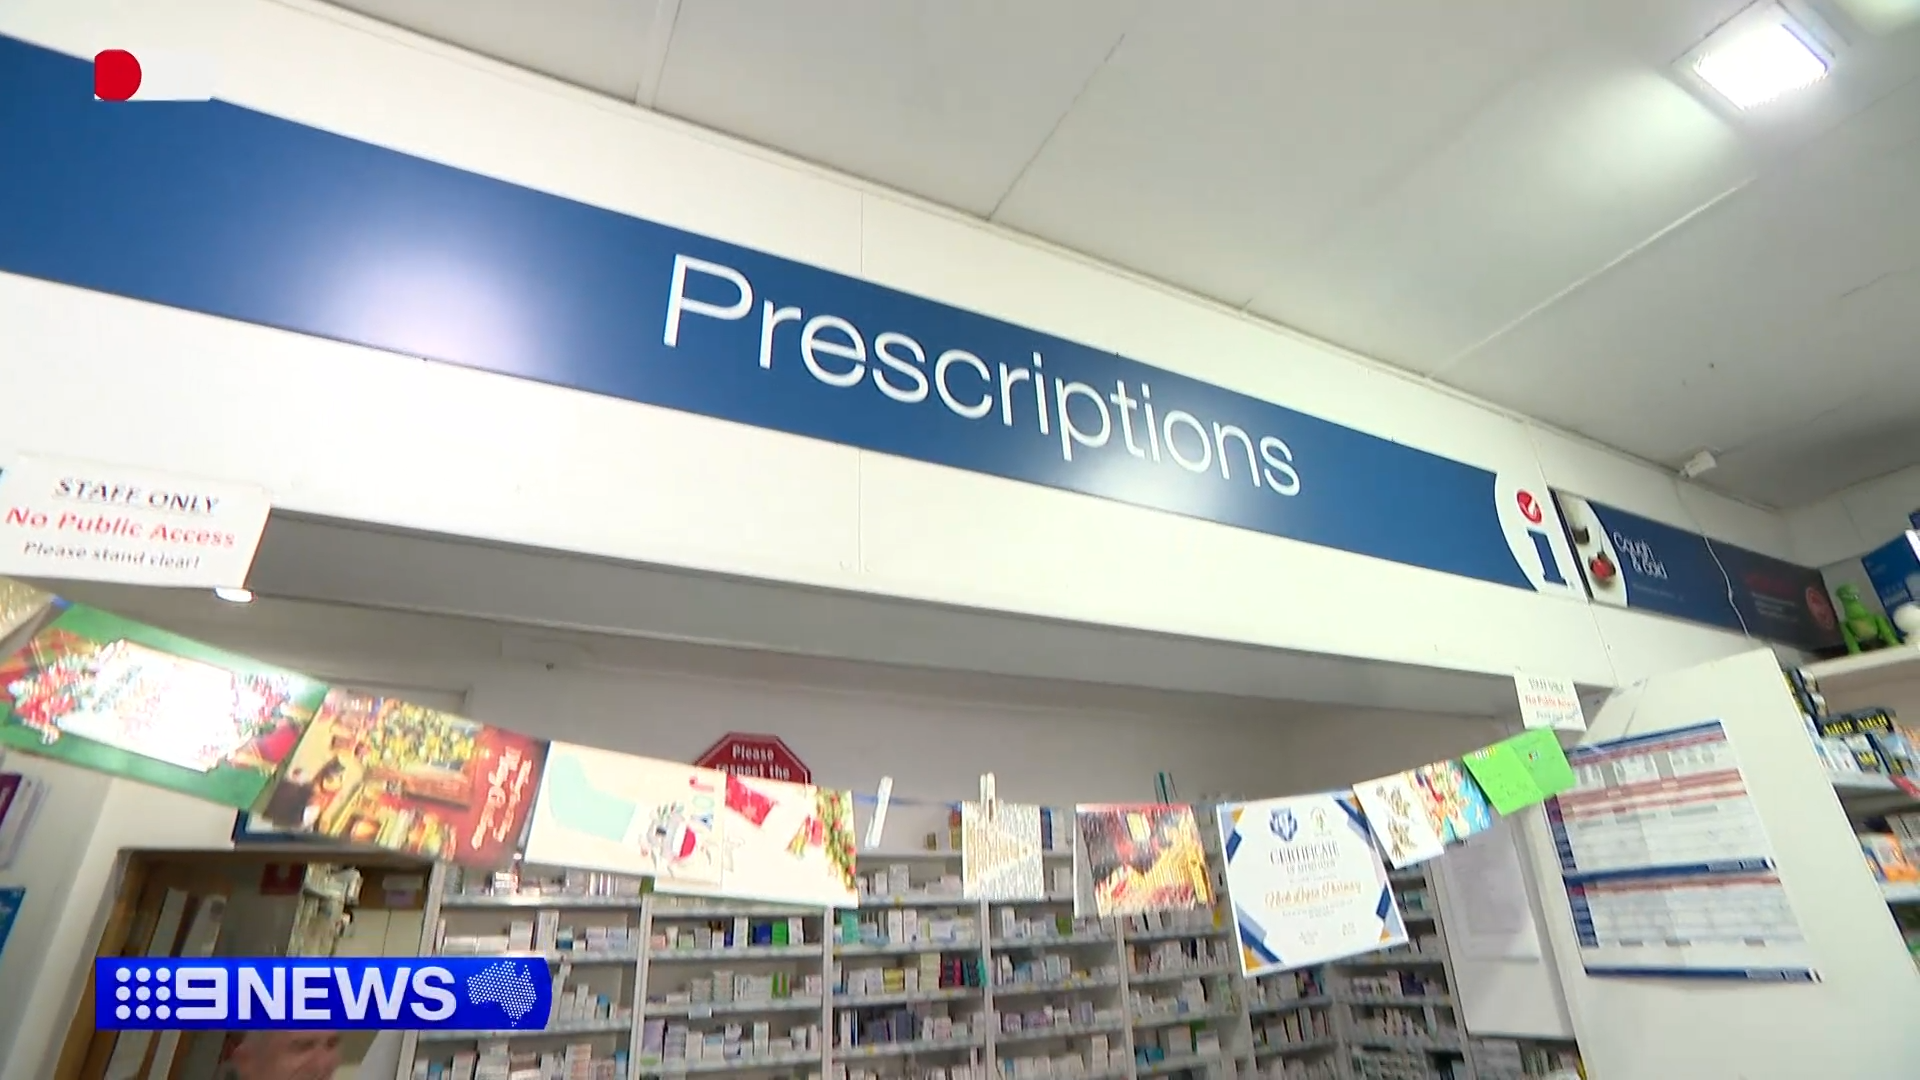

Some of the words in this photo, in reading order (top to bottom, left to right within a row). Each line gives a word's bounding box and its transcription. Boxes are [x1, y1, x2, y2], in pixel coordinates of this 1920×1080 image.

[663, 253, 1301, 496] Prescriptions
[56, 477, 142, 502] STAFF
[148, 491, 219, 513] ONLY
[6, 507, 48, 529] No
[57, 511, 143, 538] Public
[150, 523, 235, 548] Access
[23, 541, 87, 560] Please
[91, 546, 144, 566] stand
[732, 743, 774, 762] Please
[769, 764, 790, 780] the
[1270, 841, 1339, 864] CERTIFICATE
